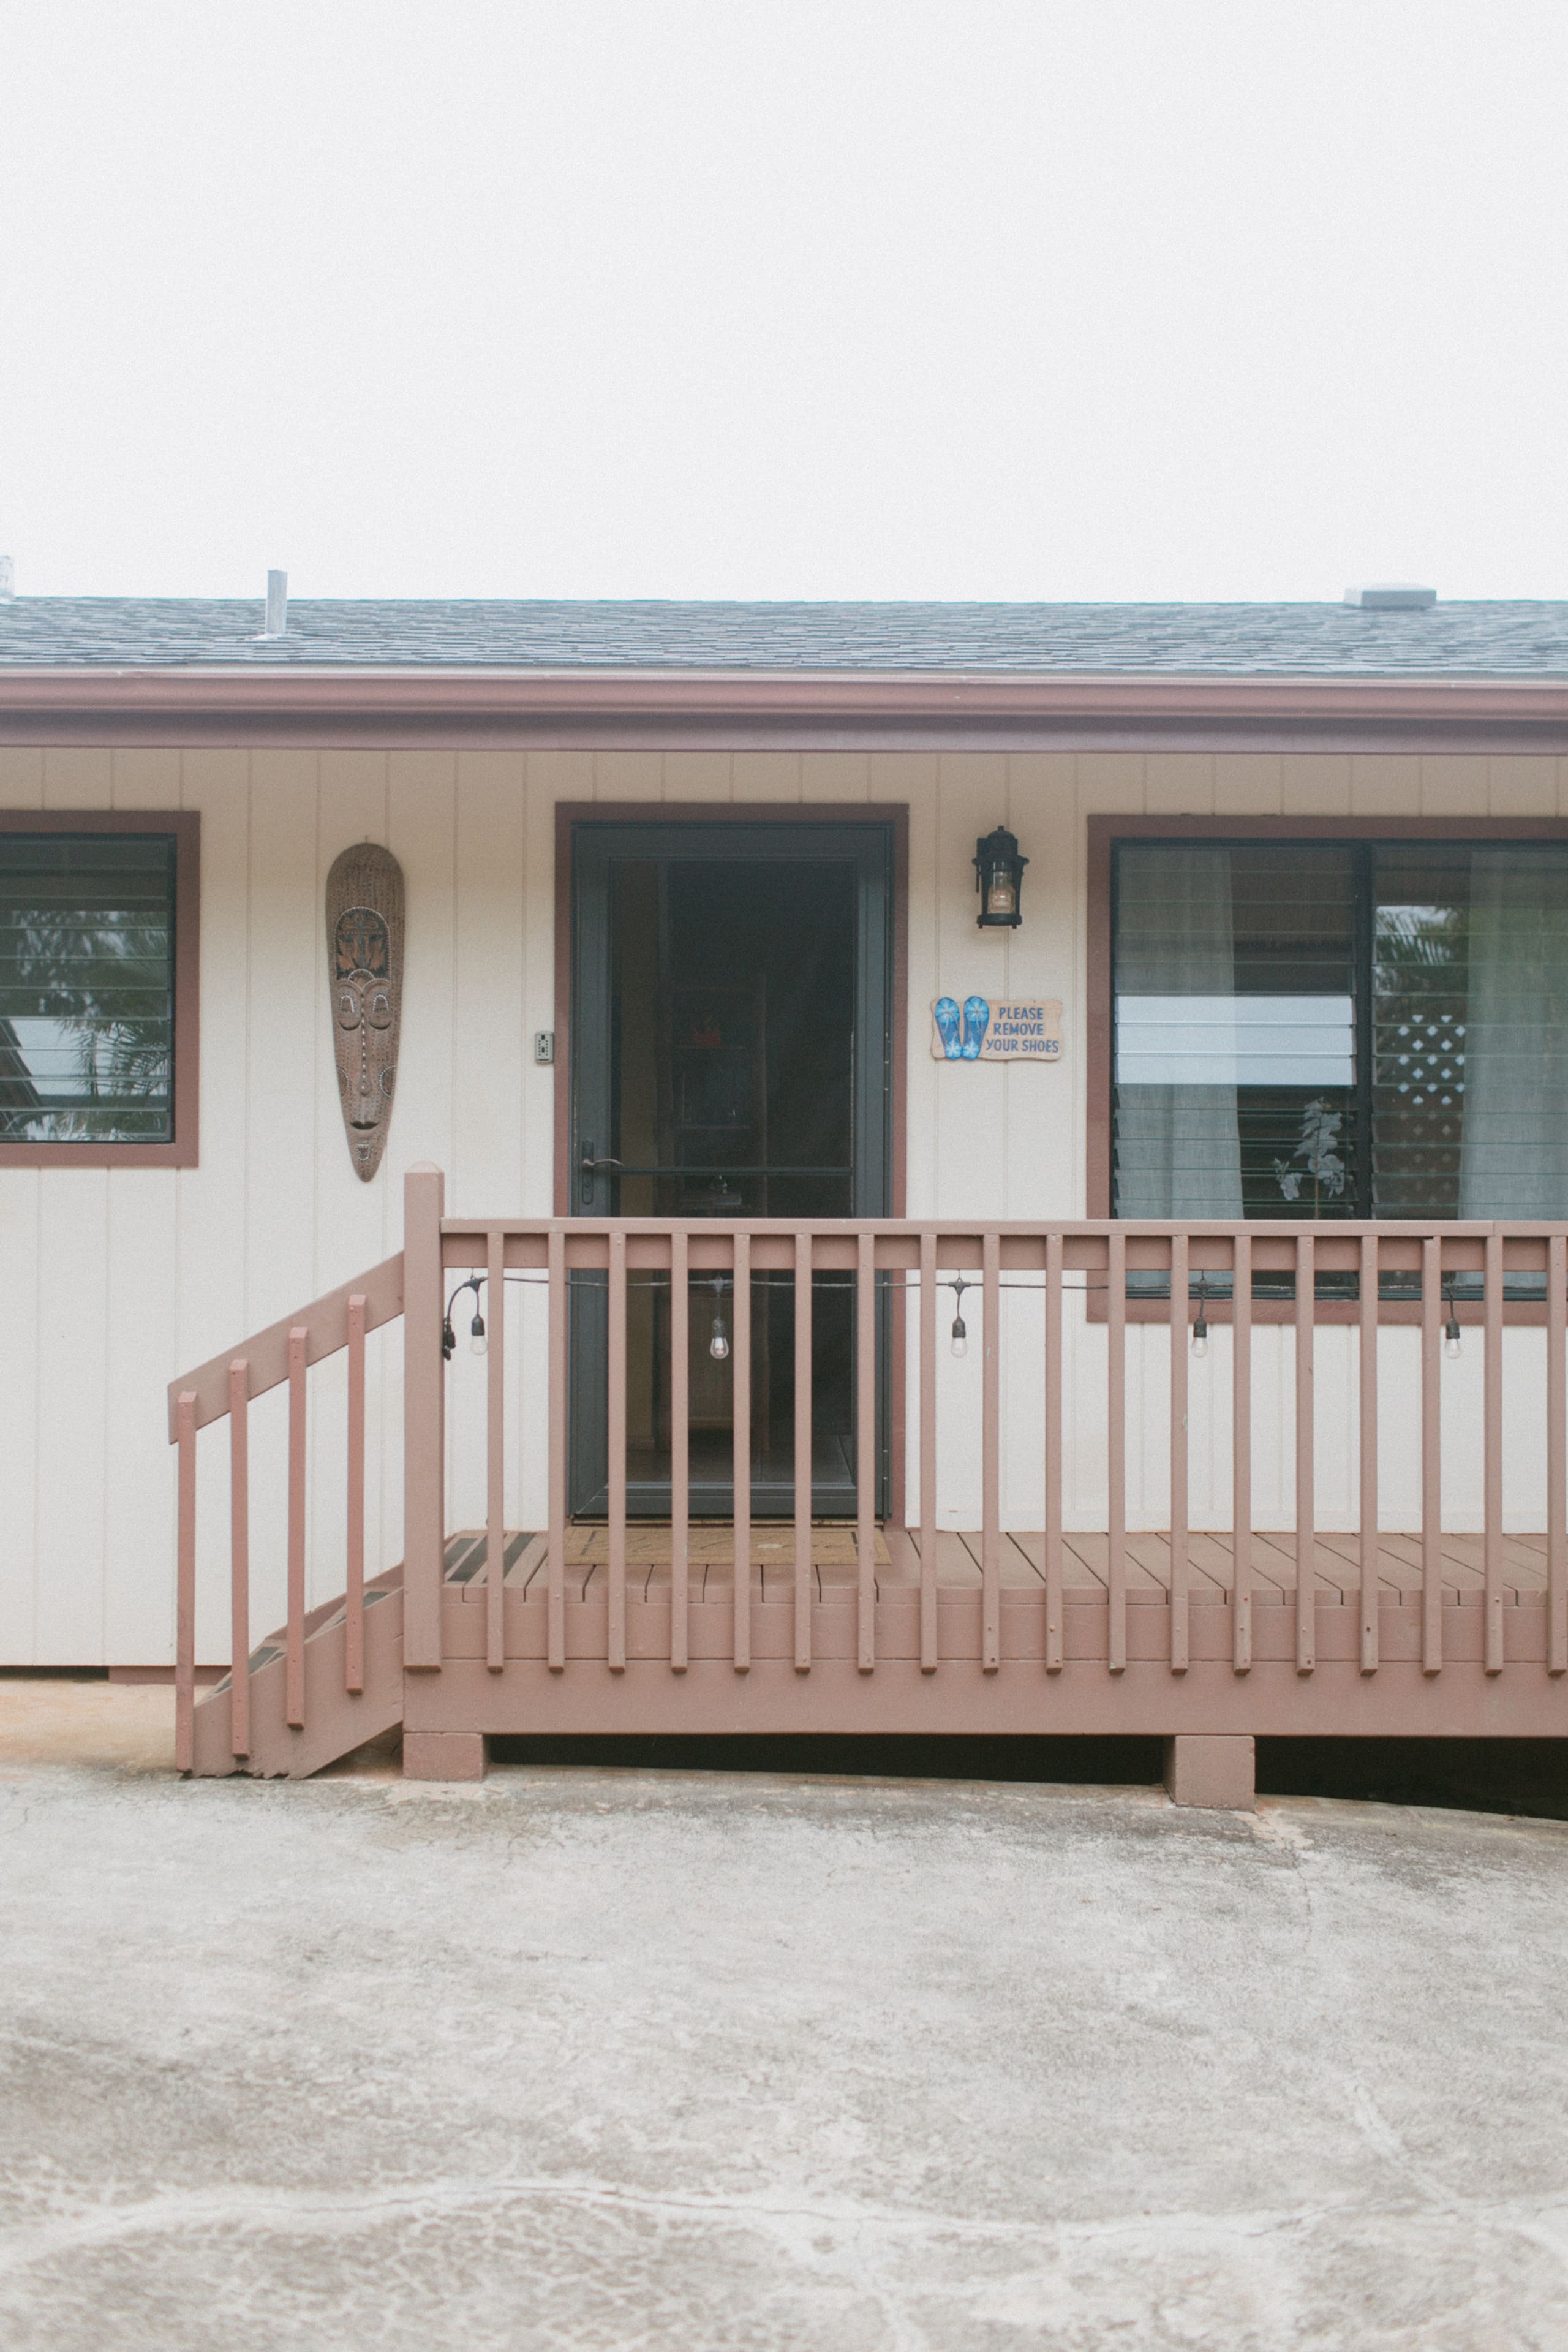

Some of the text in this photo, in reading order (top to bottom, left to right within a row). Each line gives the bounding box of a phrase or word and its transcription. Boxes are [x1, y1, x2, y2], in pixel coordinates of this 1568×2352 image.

[999, 1007, 1044, 1020] PLEASE
[993, 1023, 1044, 1035] REMOVE
[986, 1039, 1059, 1053] YOUR SHOES
